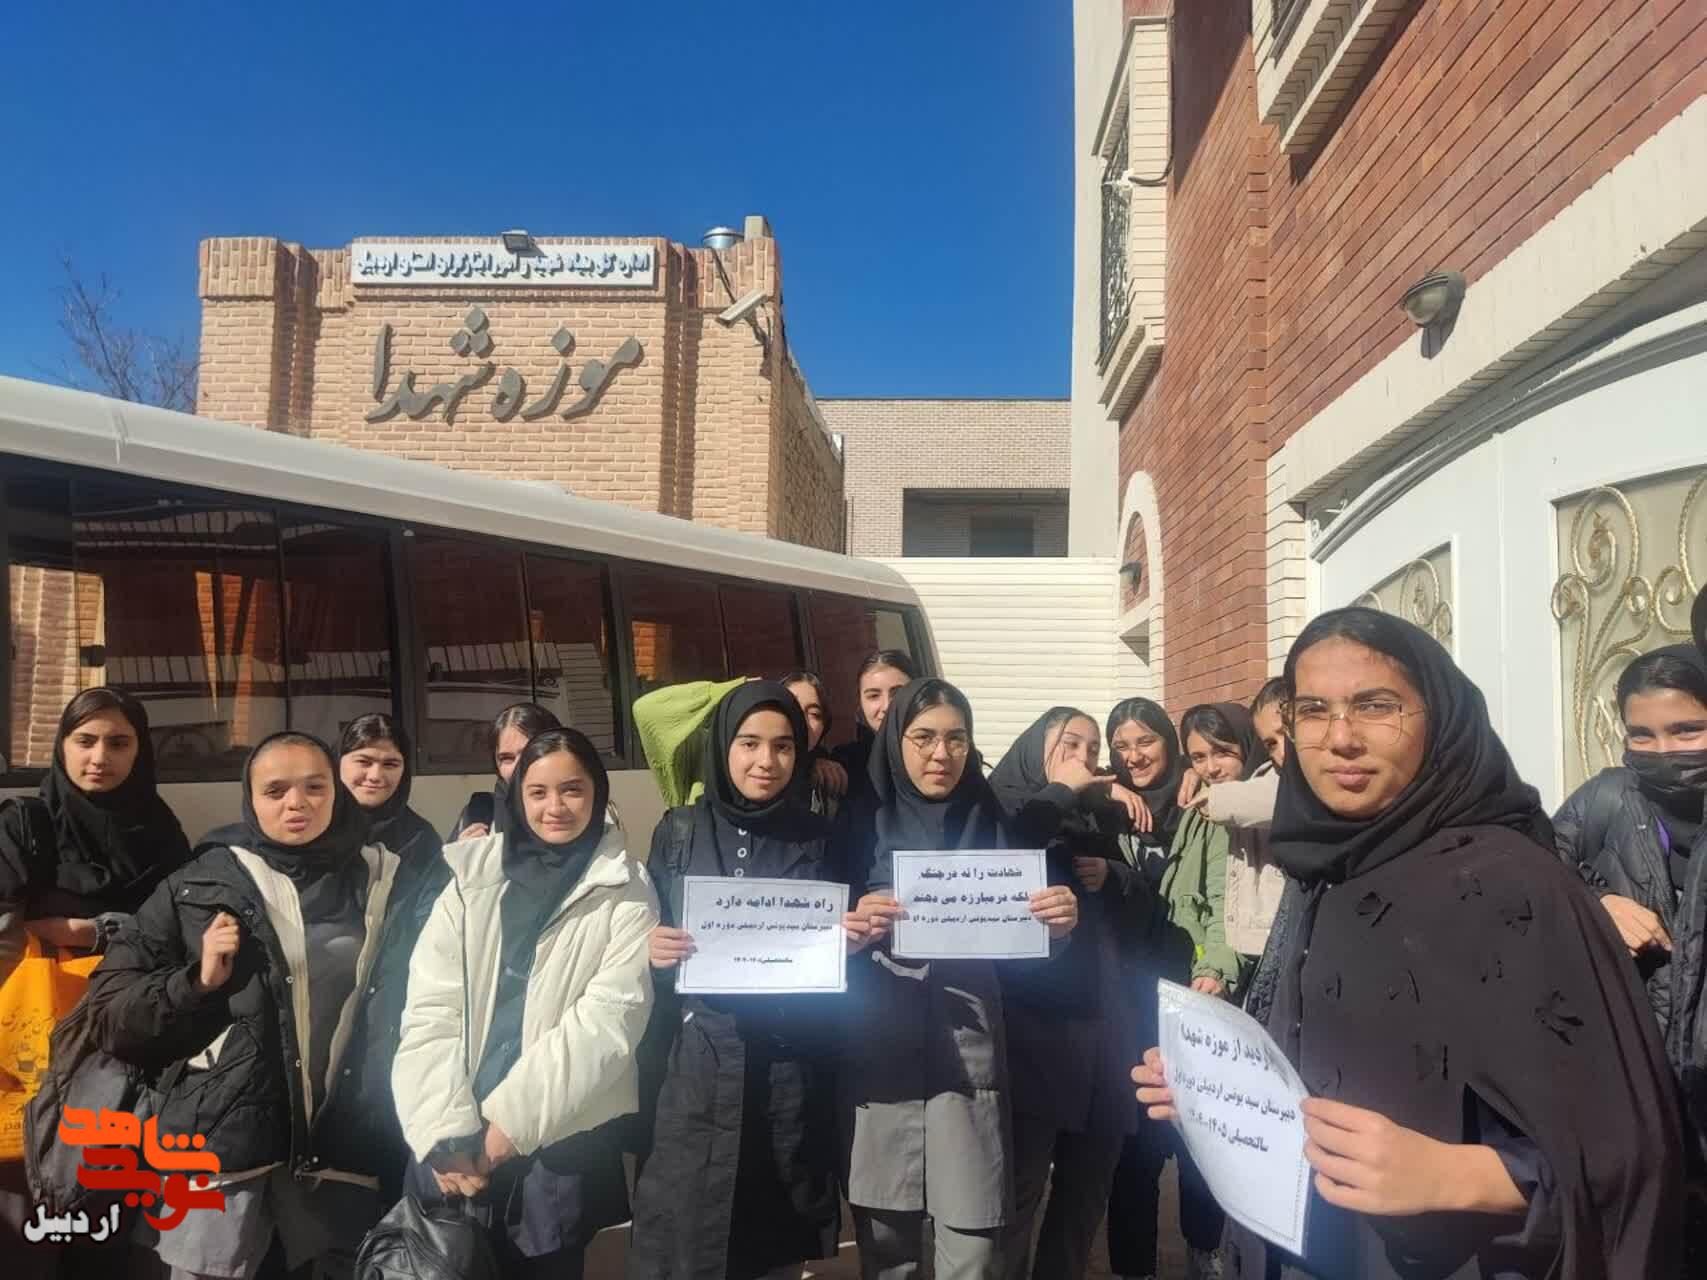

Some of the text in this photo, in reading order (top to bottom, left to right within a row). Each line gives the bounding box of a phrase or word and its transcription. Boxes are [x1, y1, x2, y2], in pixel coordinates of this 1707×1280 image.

[358, 251, 398, 277] اردبیل
[618, 252, 650, 279] اداره
[364, 305, 645, 426] موزه شهدا
[973, 867, 984, 880] را
[715, 895, 834, 912] راه شهدا ادامه دارد
[941, 895, 957, 905] می
[1010, 890, 1031, 903] لکه
[1180, 1022, 1204, 1048] شهدا
[1205, 1033, 1229, 1058] موزه
[1232, 1036, 1241, 1062] از
